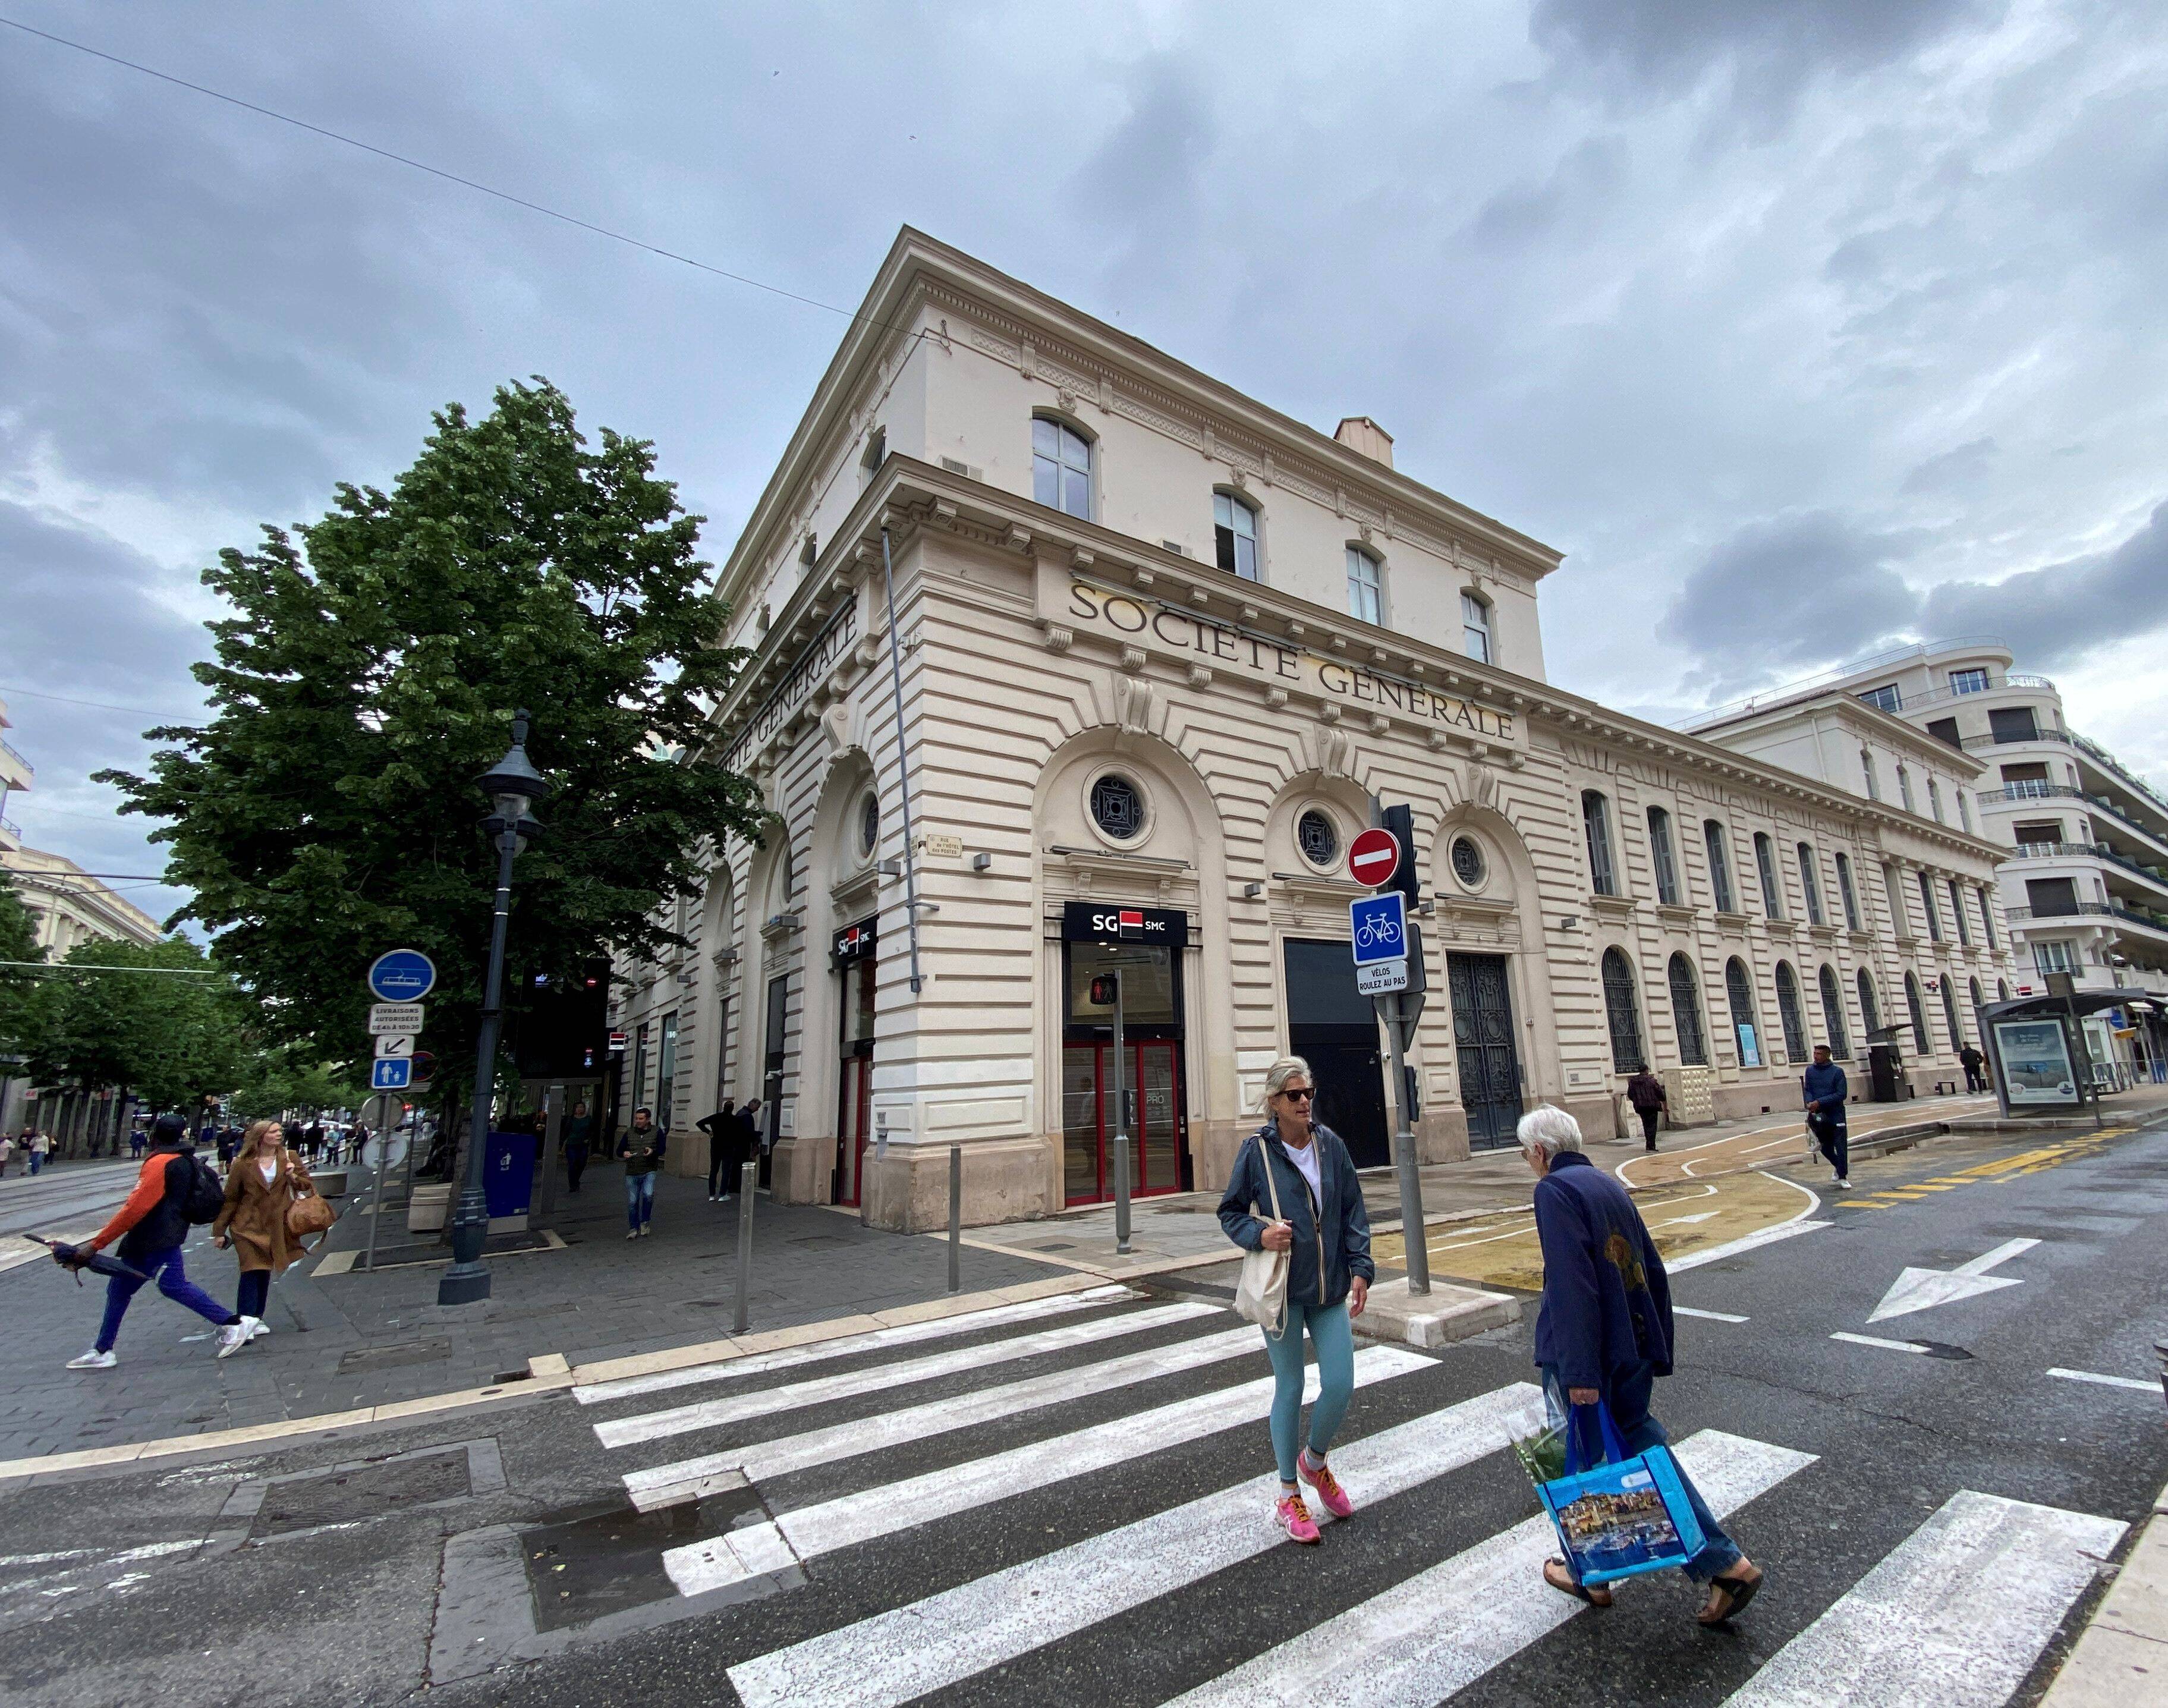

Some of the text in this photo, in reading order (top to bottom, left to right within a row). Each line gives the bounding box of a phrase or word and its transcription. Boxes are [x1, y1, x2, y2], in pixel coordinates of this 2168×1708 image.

[1093, 914, 1165, 932] SG SMC
[838, 938, 849, 955] SG
[1371, 967, 1390, 977] VÉLOS
[1360, 976, 1406, 991] ROULEZ AU PAS
[1146, 1095, 1164, 1104] PRO
